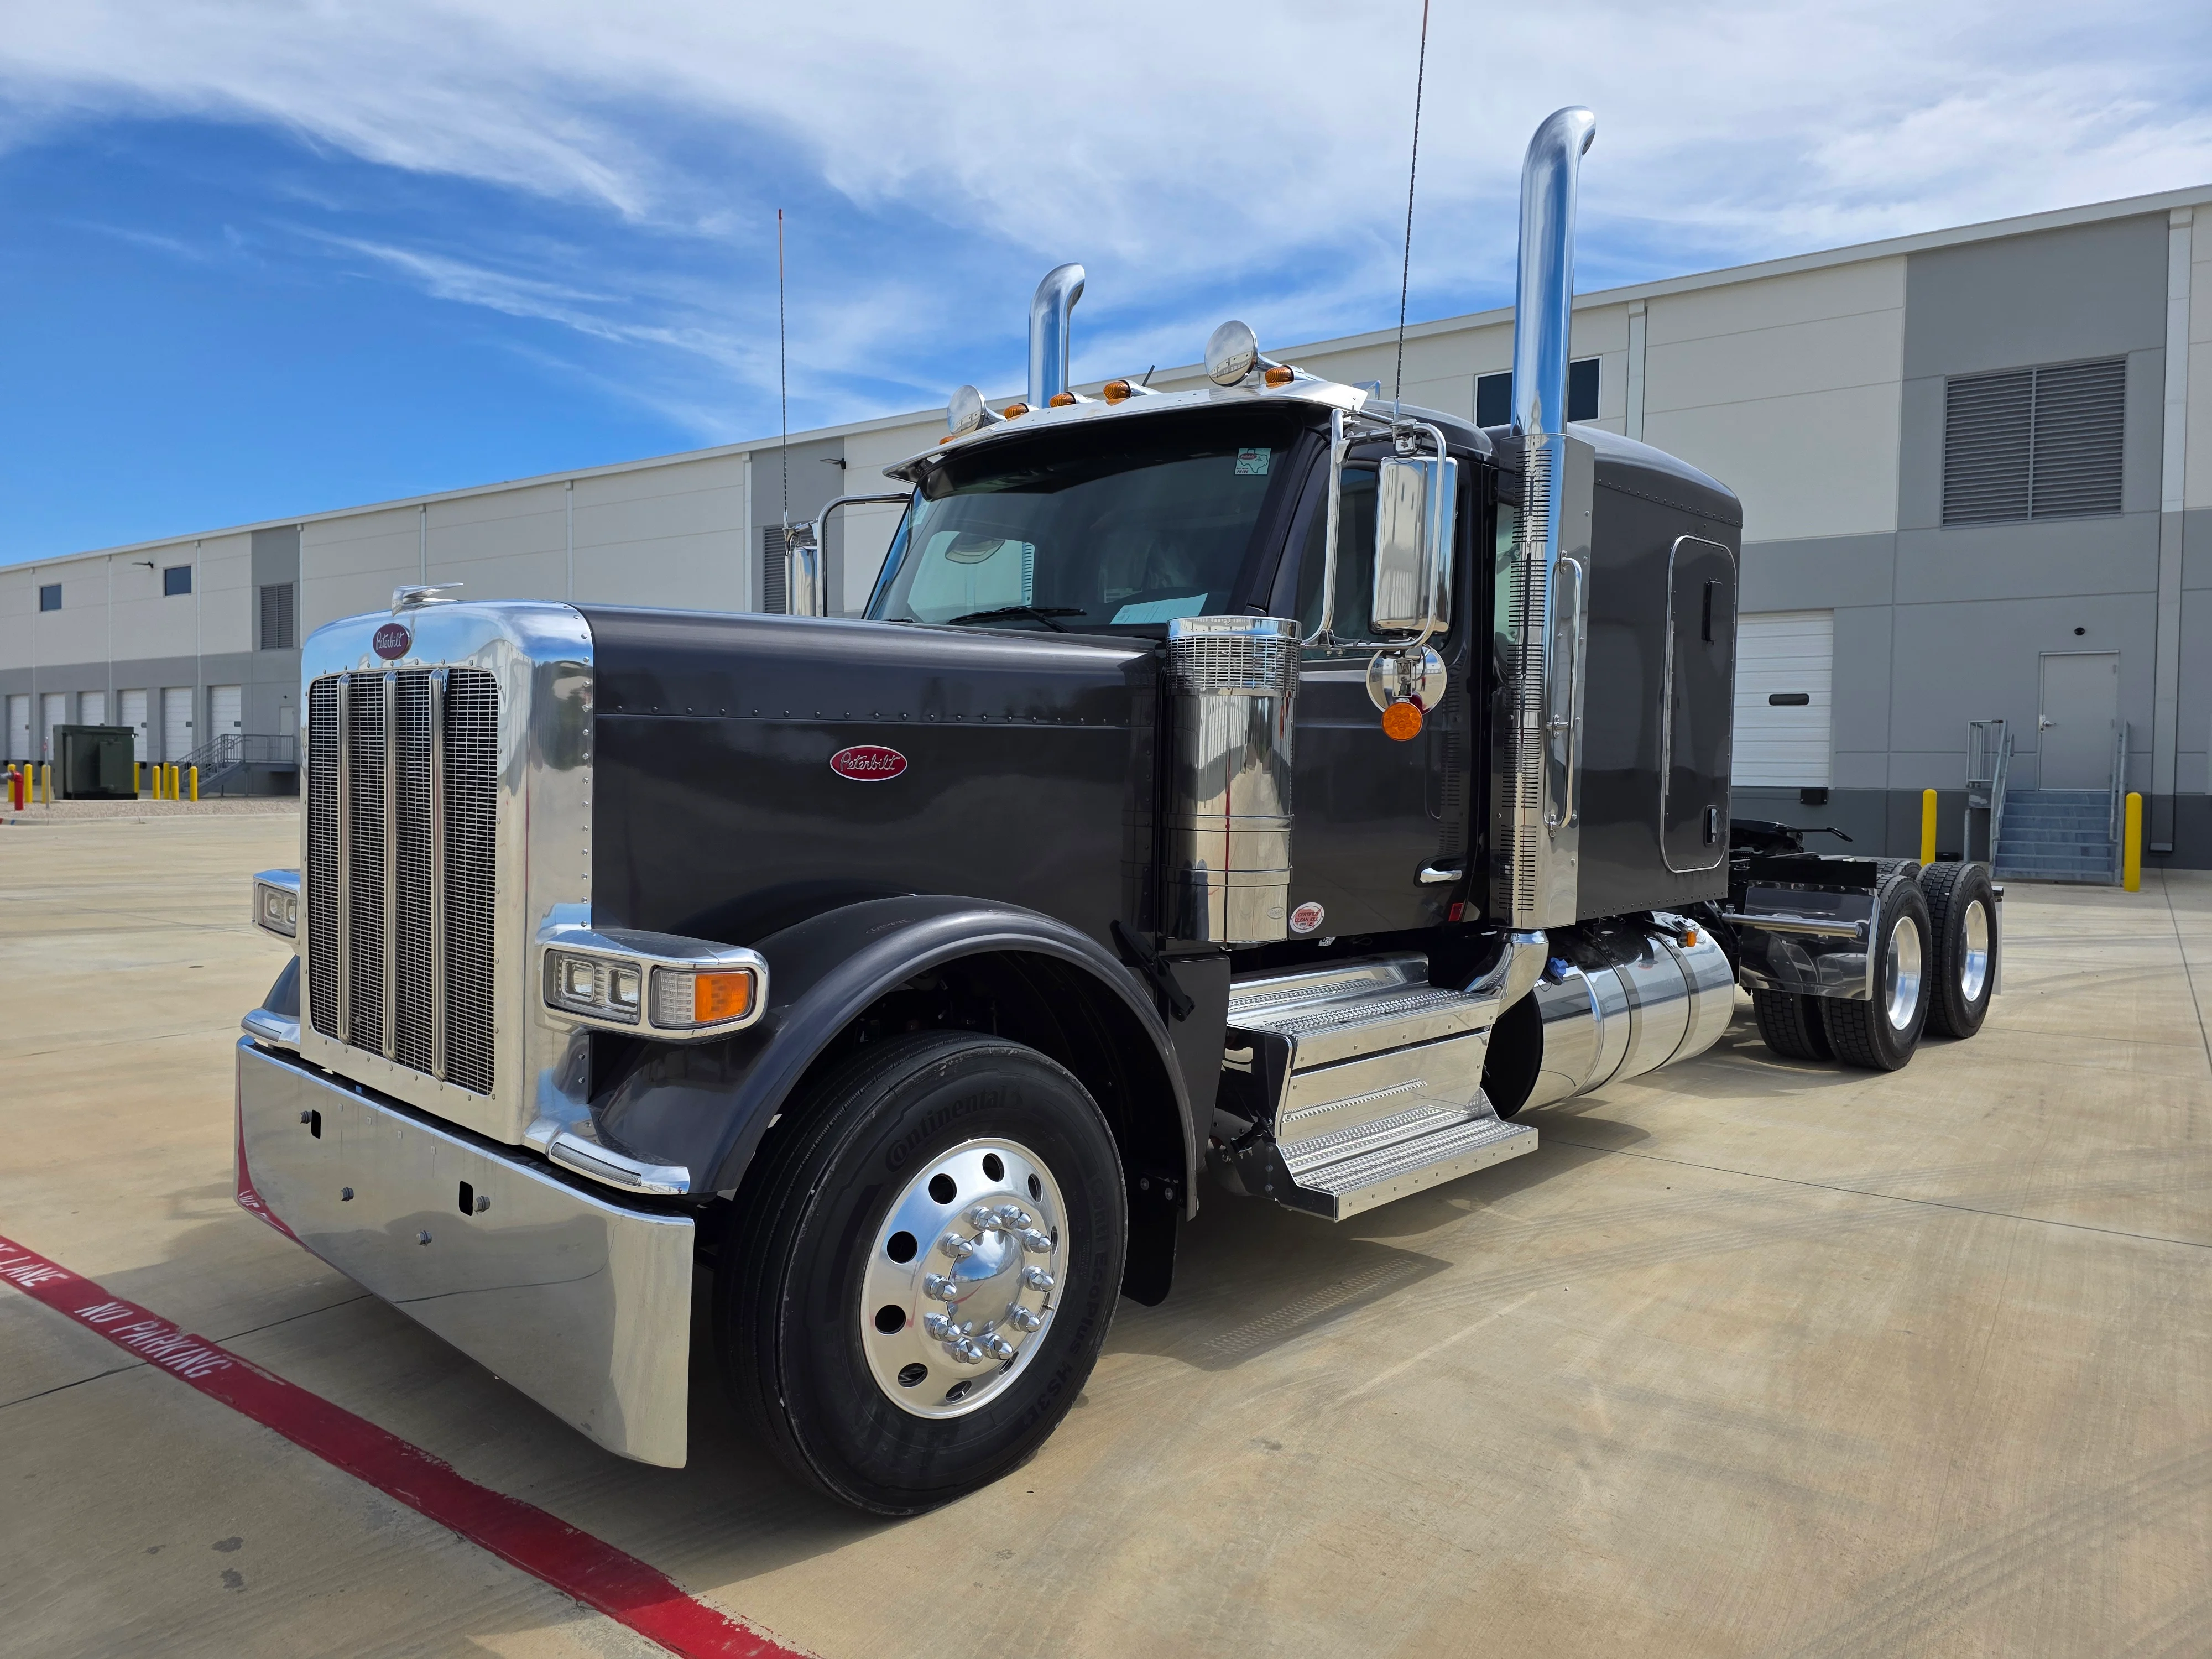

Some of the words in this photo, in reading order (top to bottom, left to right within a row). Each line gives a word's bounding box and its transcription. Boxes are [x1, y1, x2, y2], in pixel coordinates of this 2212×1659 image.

[376, 631, 405, 651] Peterbilt
[840, 752, 901, 772] Peterbilt
[885, 1085, 1008, 1172] Continental
[0, 1256, 70, 1287] LANE
[74, 1302, 134, 1323] NO
[109, 1320, 232, 1378] PARKING
